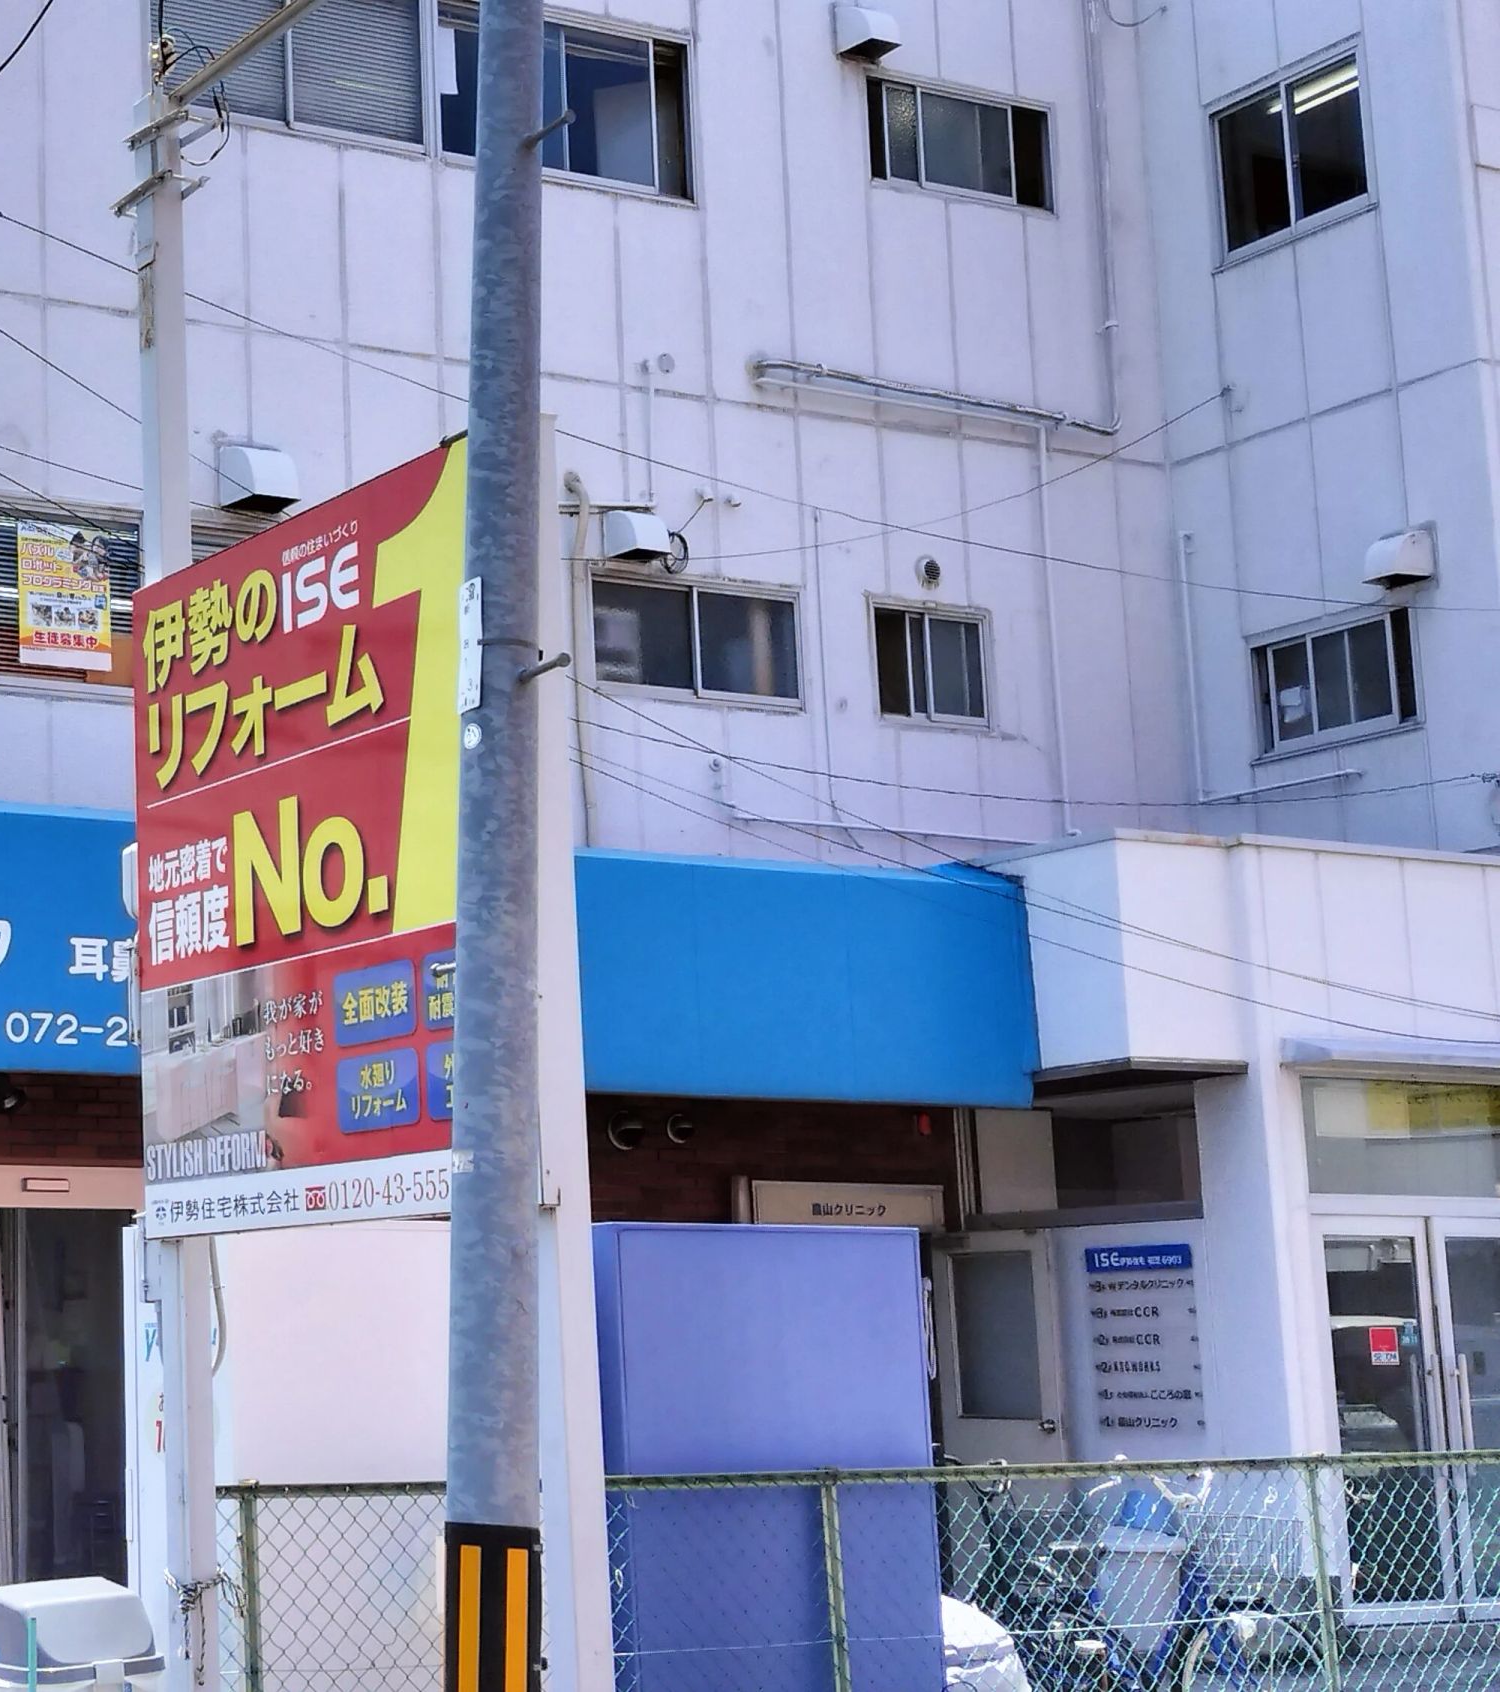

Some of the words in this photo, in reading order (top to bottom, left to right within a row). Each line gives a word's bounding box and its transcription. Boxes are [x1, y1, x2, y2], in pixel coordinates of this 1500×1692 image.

[21, 558, 62, 572] ロボット
[142, 569, 277, 694] 伊勢の
[282, 541, 360, 634] ISE
[33, 631, 98, 649] 生徒募集中
[148, 624, 384, 790] リフォーム
[148, 836, 228, 893] 地元密着で
[148, 885, 229, 966] 信頼度
[263, 990, 323, 1026] 我が家が
[342, 980, 409, 1026] 全面改装
[6, 1011, 128, 1047] 072-2
[264, 1028, 325, 1060] もっと好き
[351, 1089, 408, 1120] リフォーム
[147, 1138, 201, 1181] STYLISH
[207, 1130, 267, 1174] REFORM
[170, 1188, 300, 1223] 伊勢住宅株式会社
